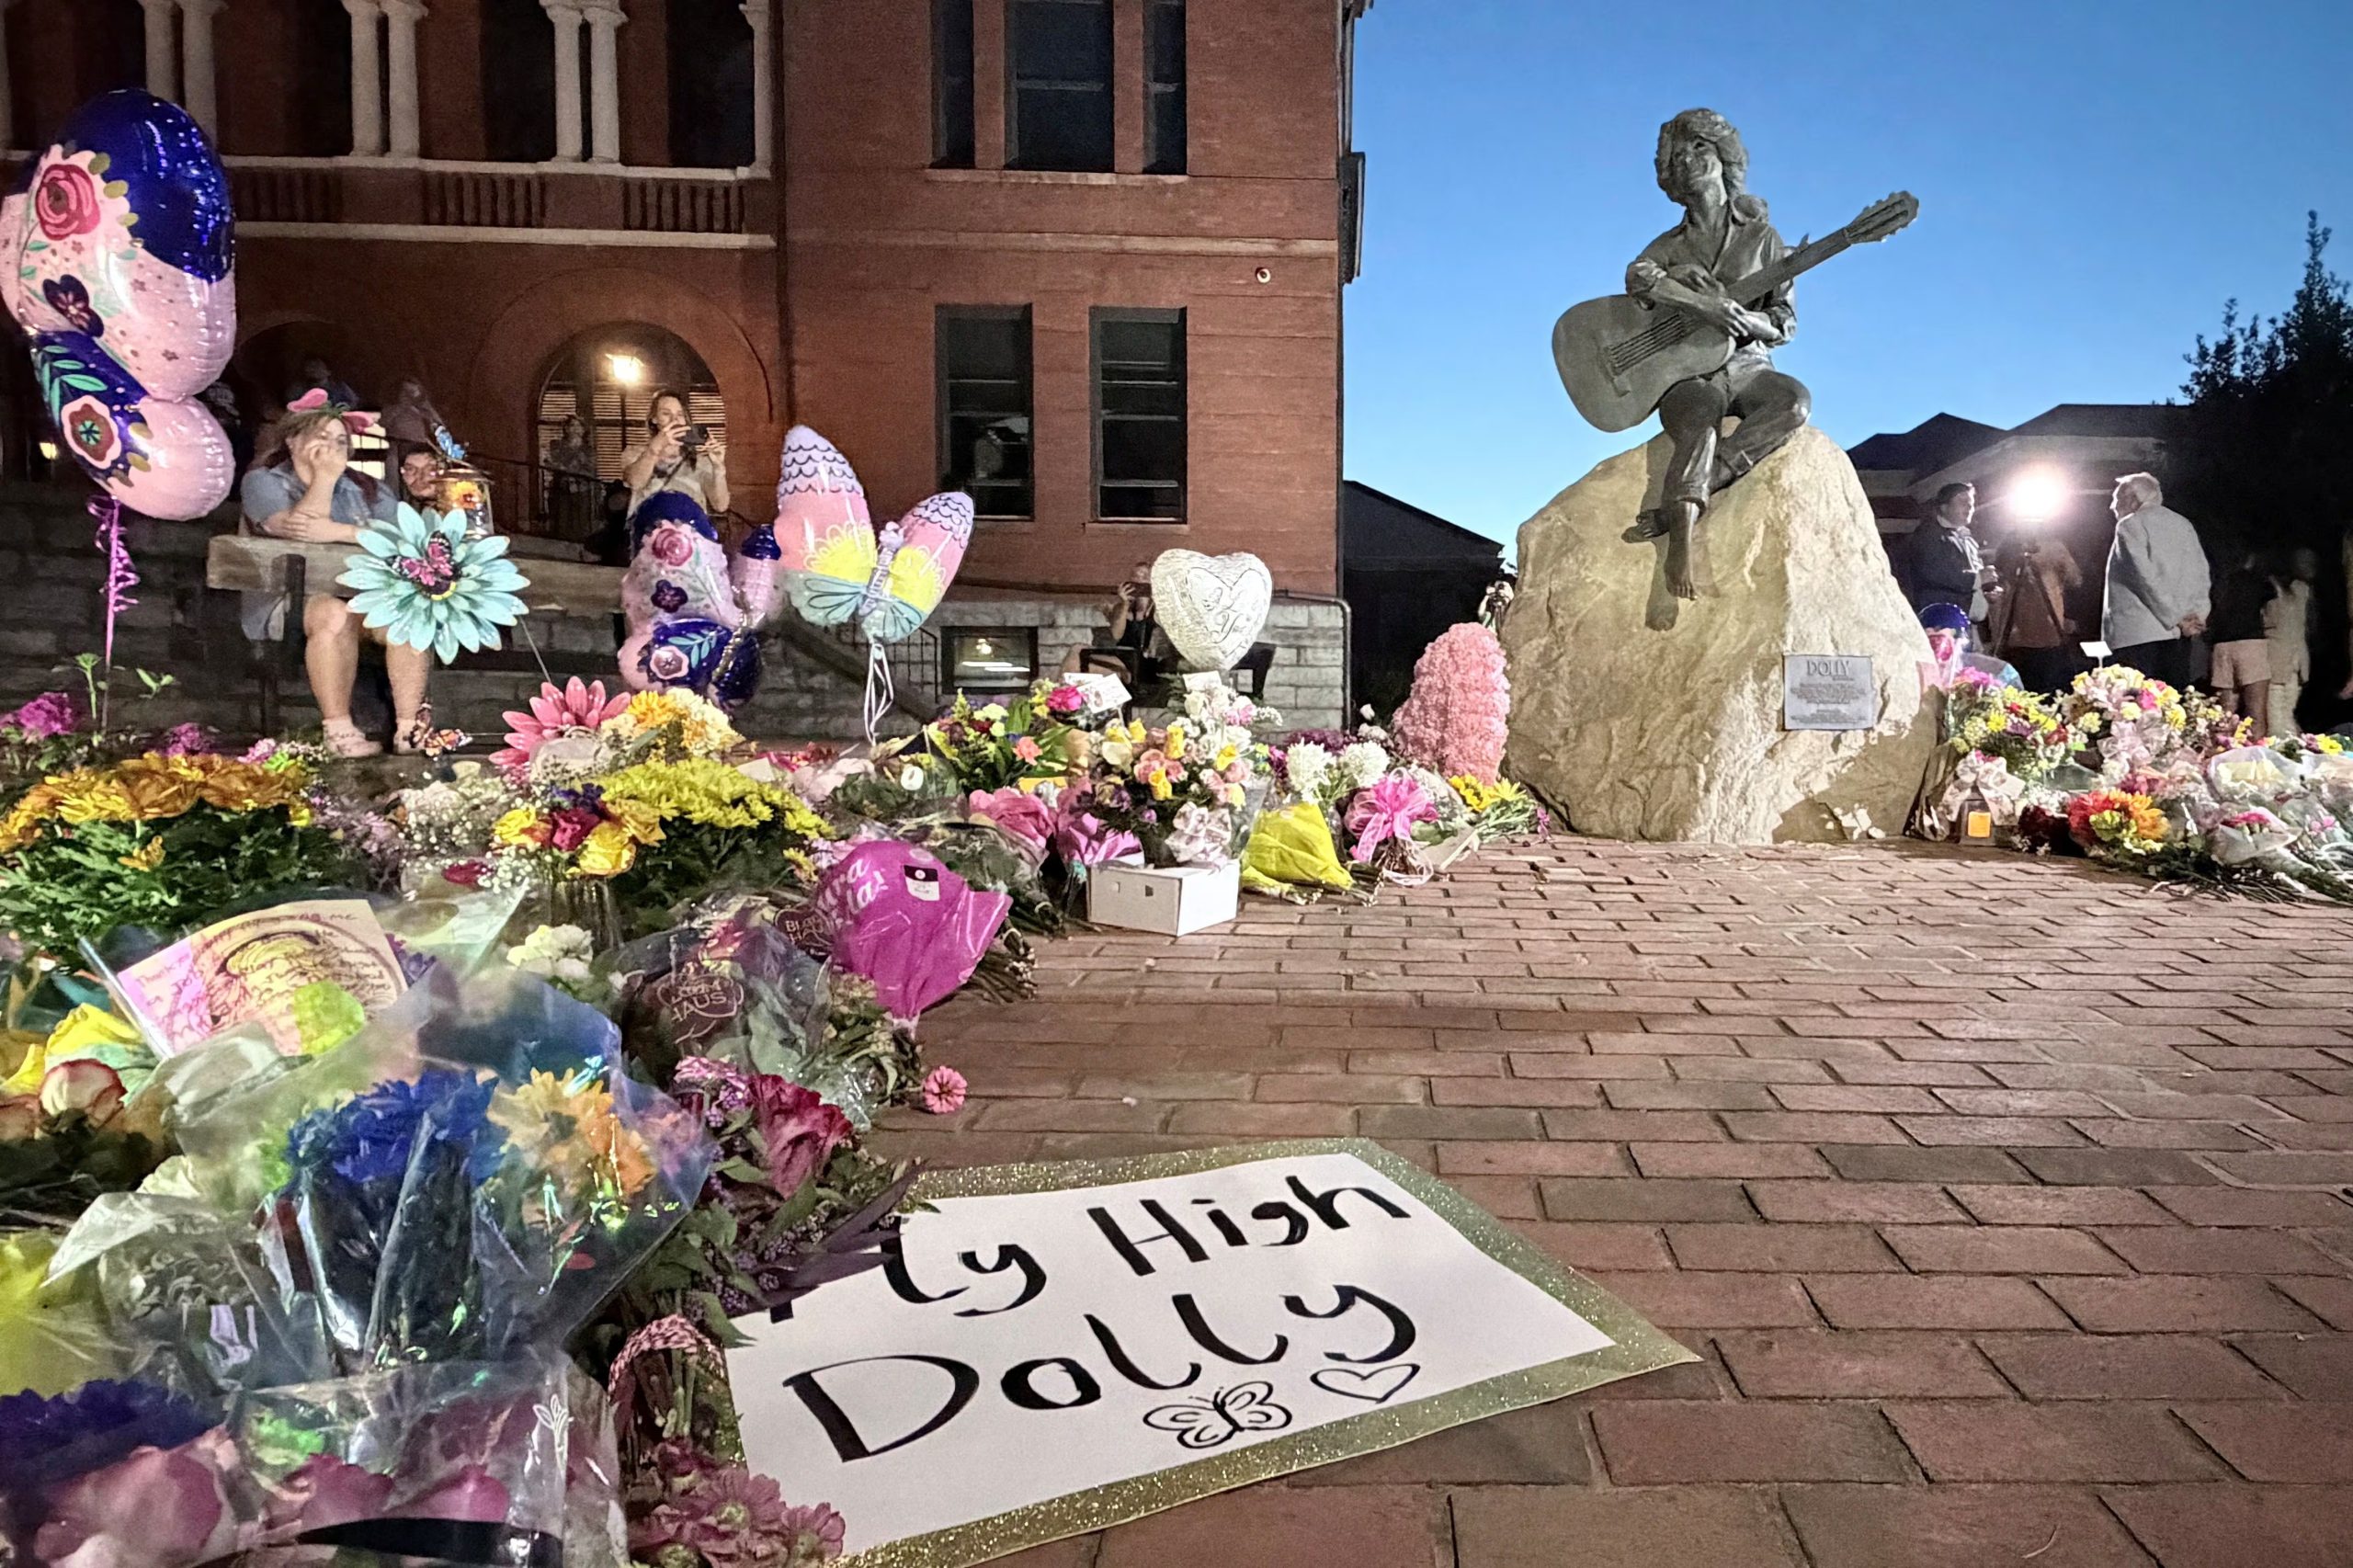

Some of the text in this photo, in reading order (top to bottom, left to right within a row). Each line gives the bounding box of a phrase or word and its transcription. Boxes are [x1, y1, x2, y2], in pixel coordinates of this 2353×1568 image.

[770, 1175, 1412, 1324] ly High
[782, 1284, 1416, 1463] Dolly
